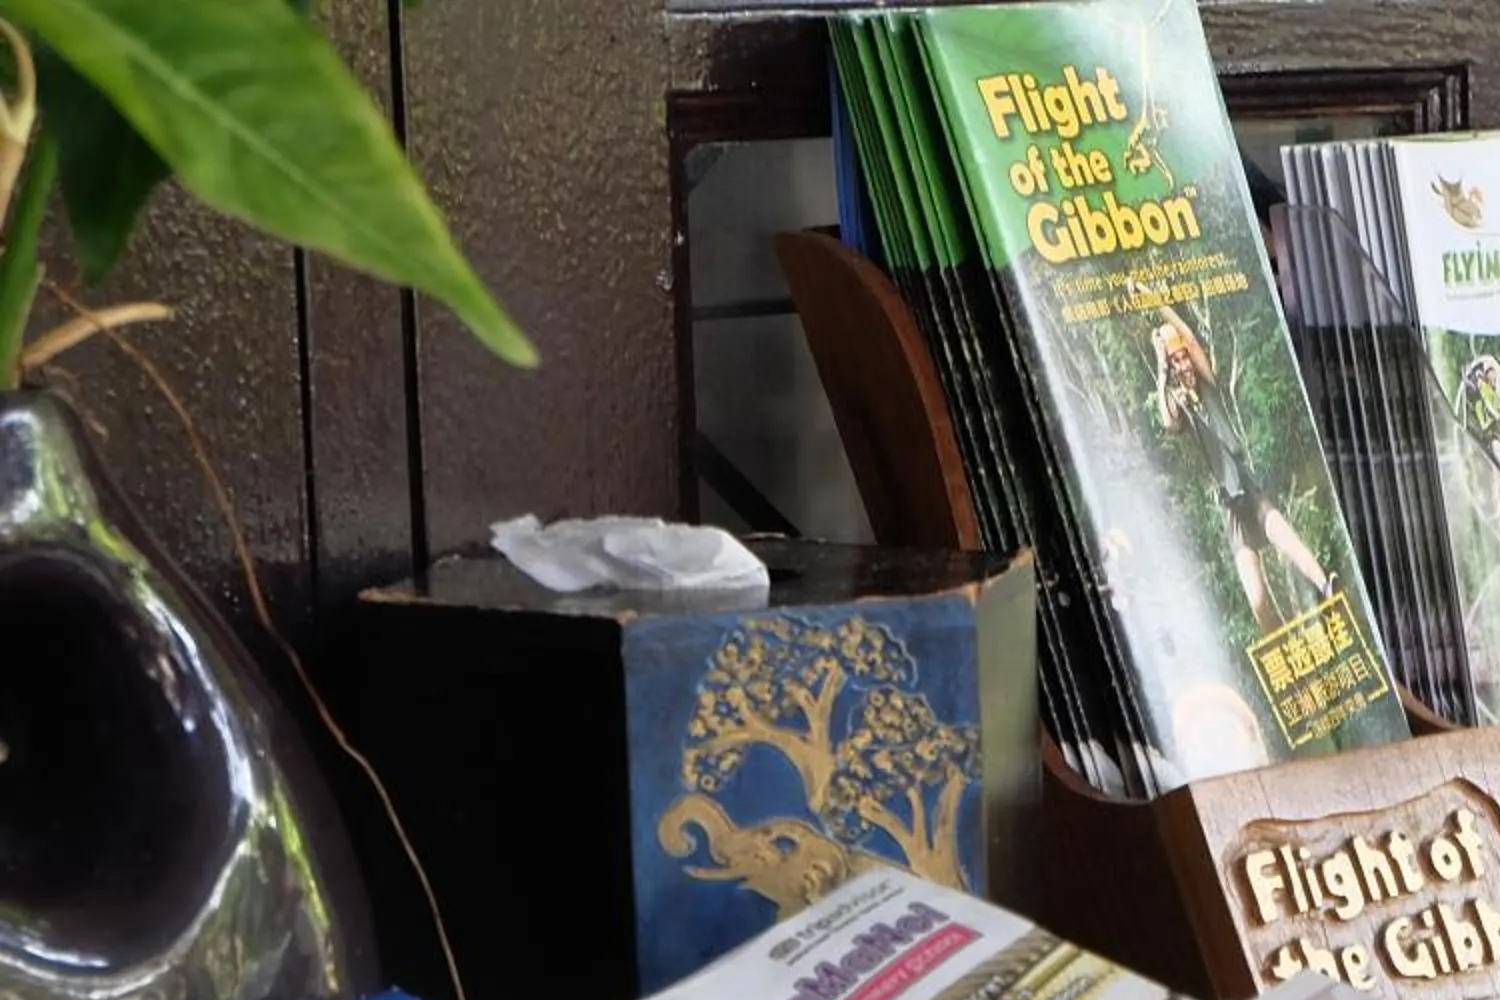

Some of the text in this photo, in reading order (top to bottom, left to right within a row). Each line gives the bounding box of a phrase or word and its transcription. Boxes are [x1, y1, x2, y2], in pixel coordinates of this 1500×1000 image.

[978, 66, 1127, 139] Flight
[1009, 144, 1111, 196] of the
[1027, 195, 1201, 264] Gibbon
[1244, 808, 1485, 926] Flight of
[1272, 937, 1377, 991] the
